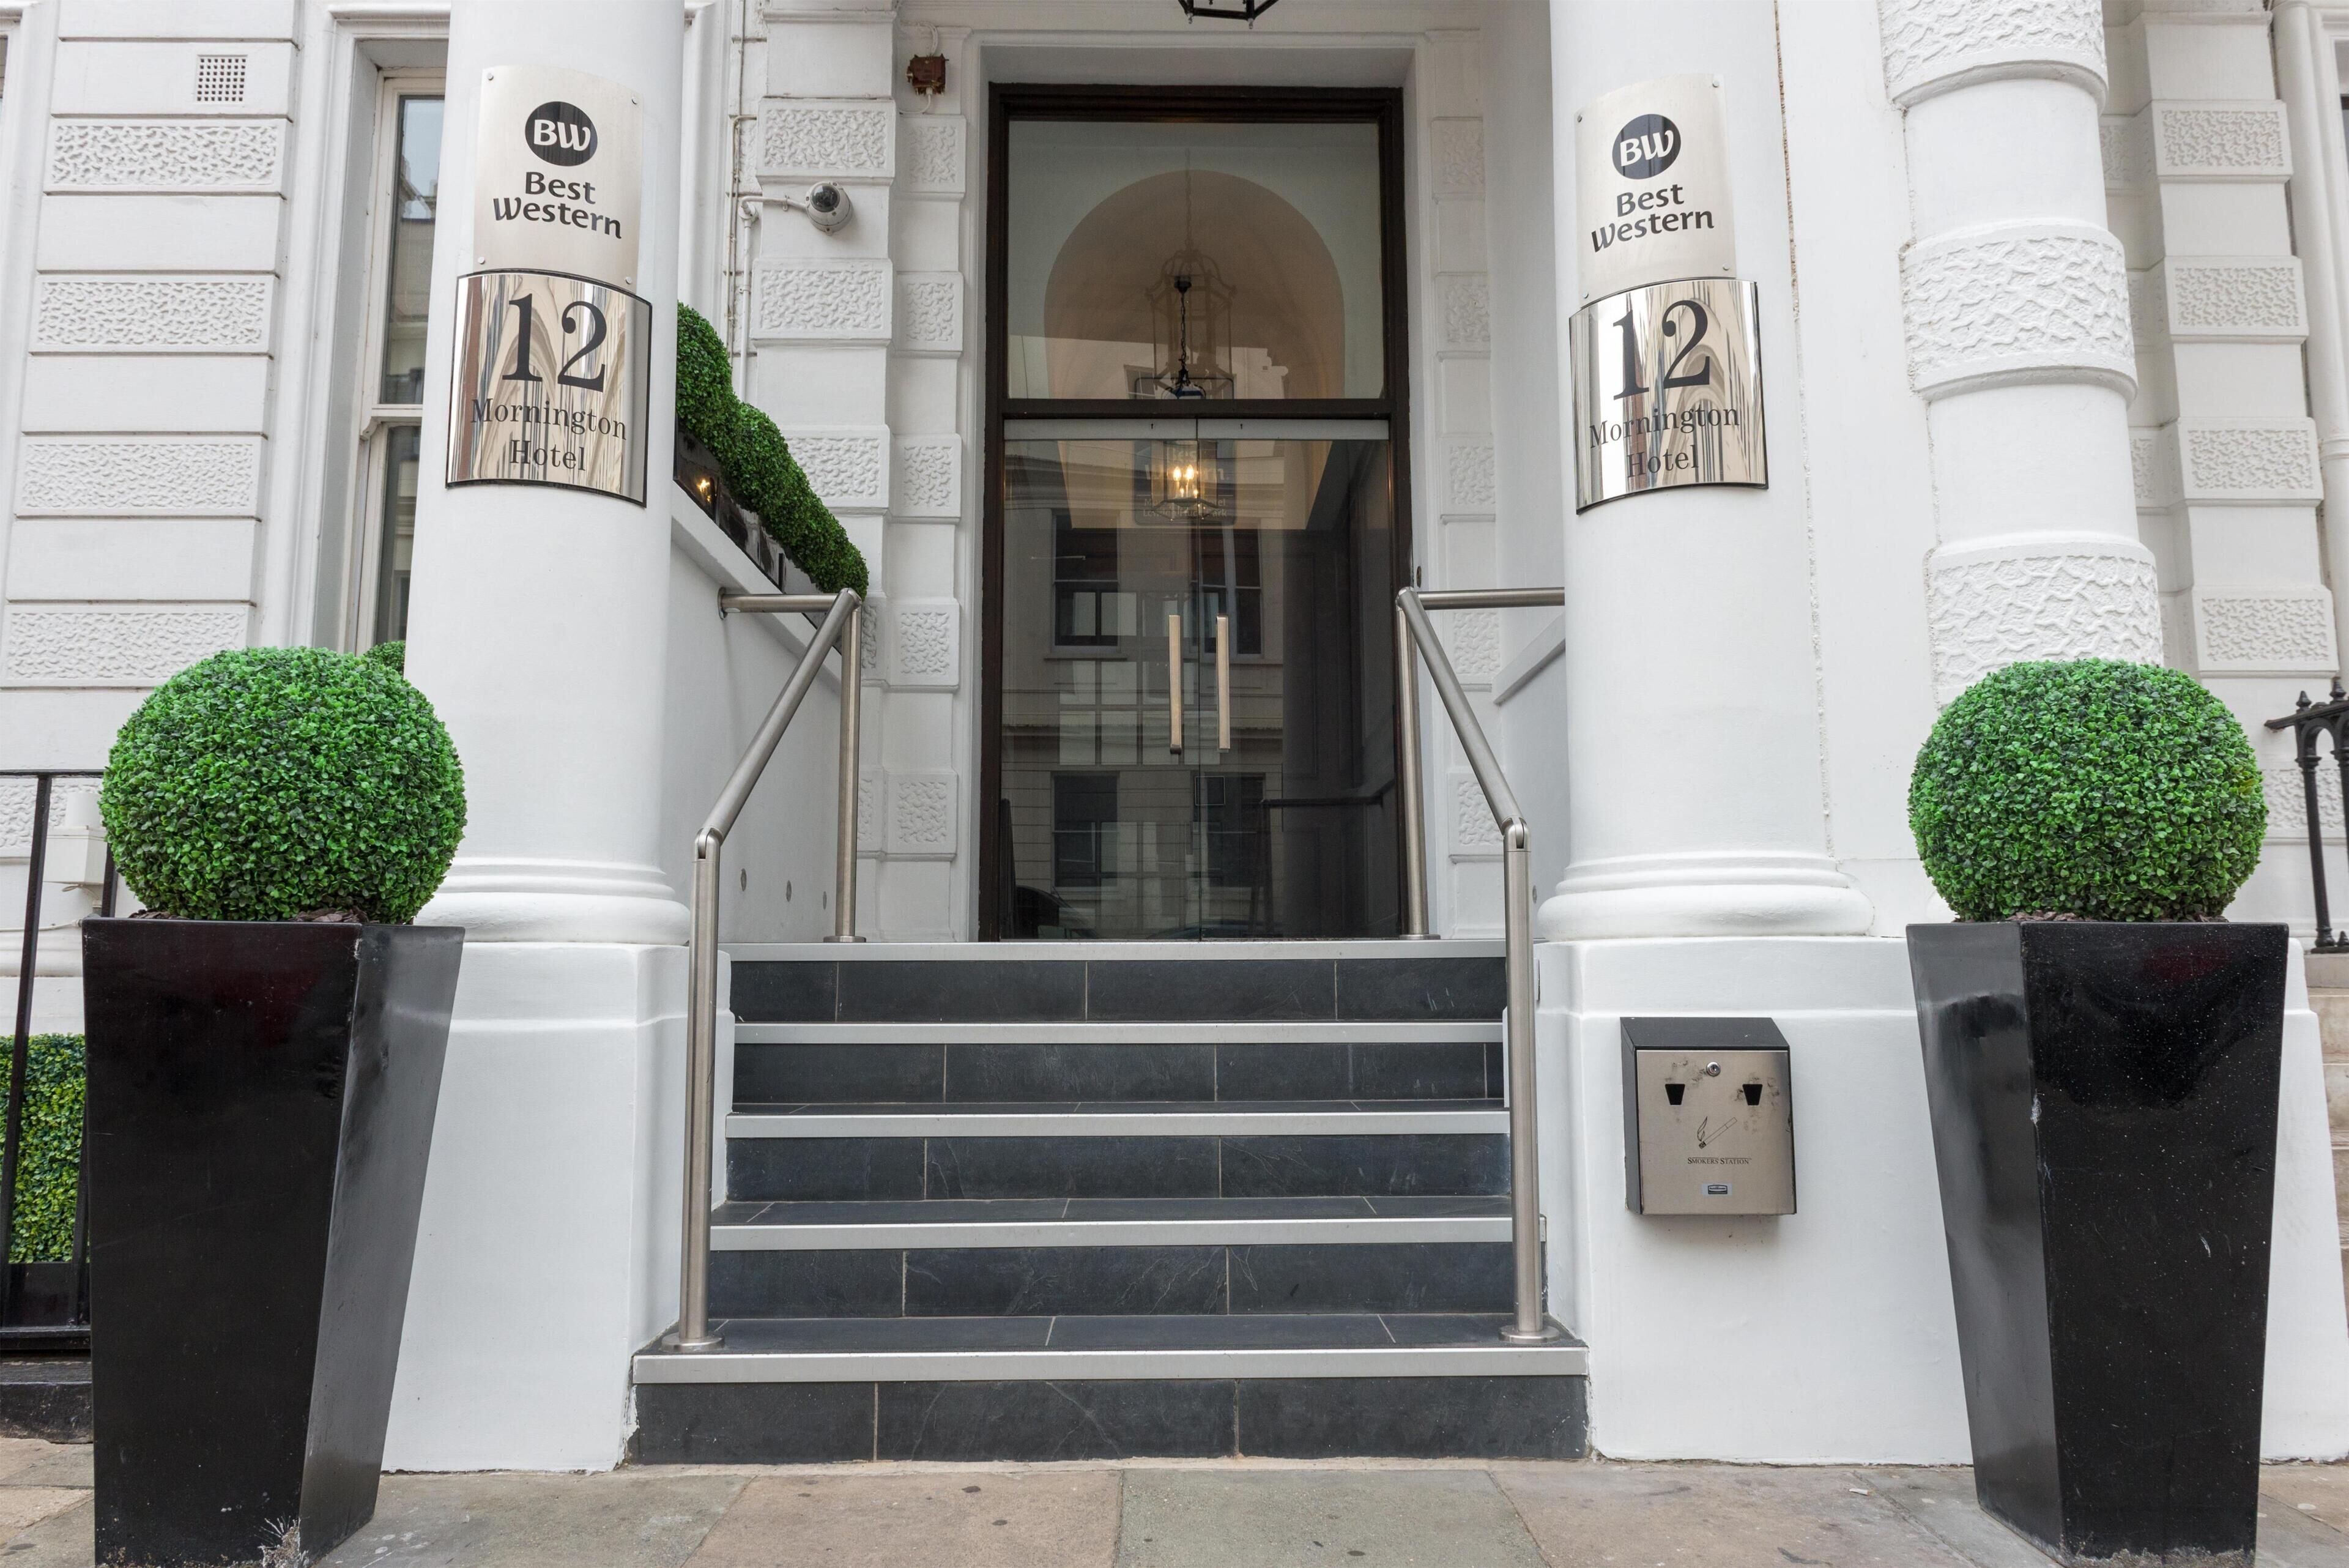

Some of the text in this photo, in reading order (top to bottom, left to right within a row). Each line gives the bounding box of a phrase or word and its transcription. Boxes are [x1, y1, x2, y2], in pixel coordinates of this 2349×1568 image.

[533, 119, 591, 151] BW
[1620, 130, 1674, 167] BW
[525, 171, 596, 204] Best
[1617, 184, 1685, 217] Best
[493, 197, 622, 239] Western
[1591, 210, 1715, 253] Western
[502, 293, 607, 393] 12
[1613, 300, 1710, 401] 12
[470, 398, 626, 440] Mornington
[1589, 404, 1740, 448] Mornington
[510, 440, 586, 471] Hotel
[1627, 445, 1699, 478] Hotel
